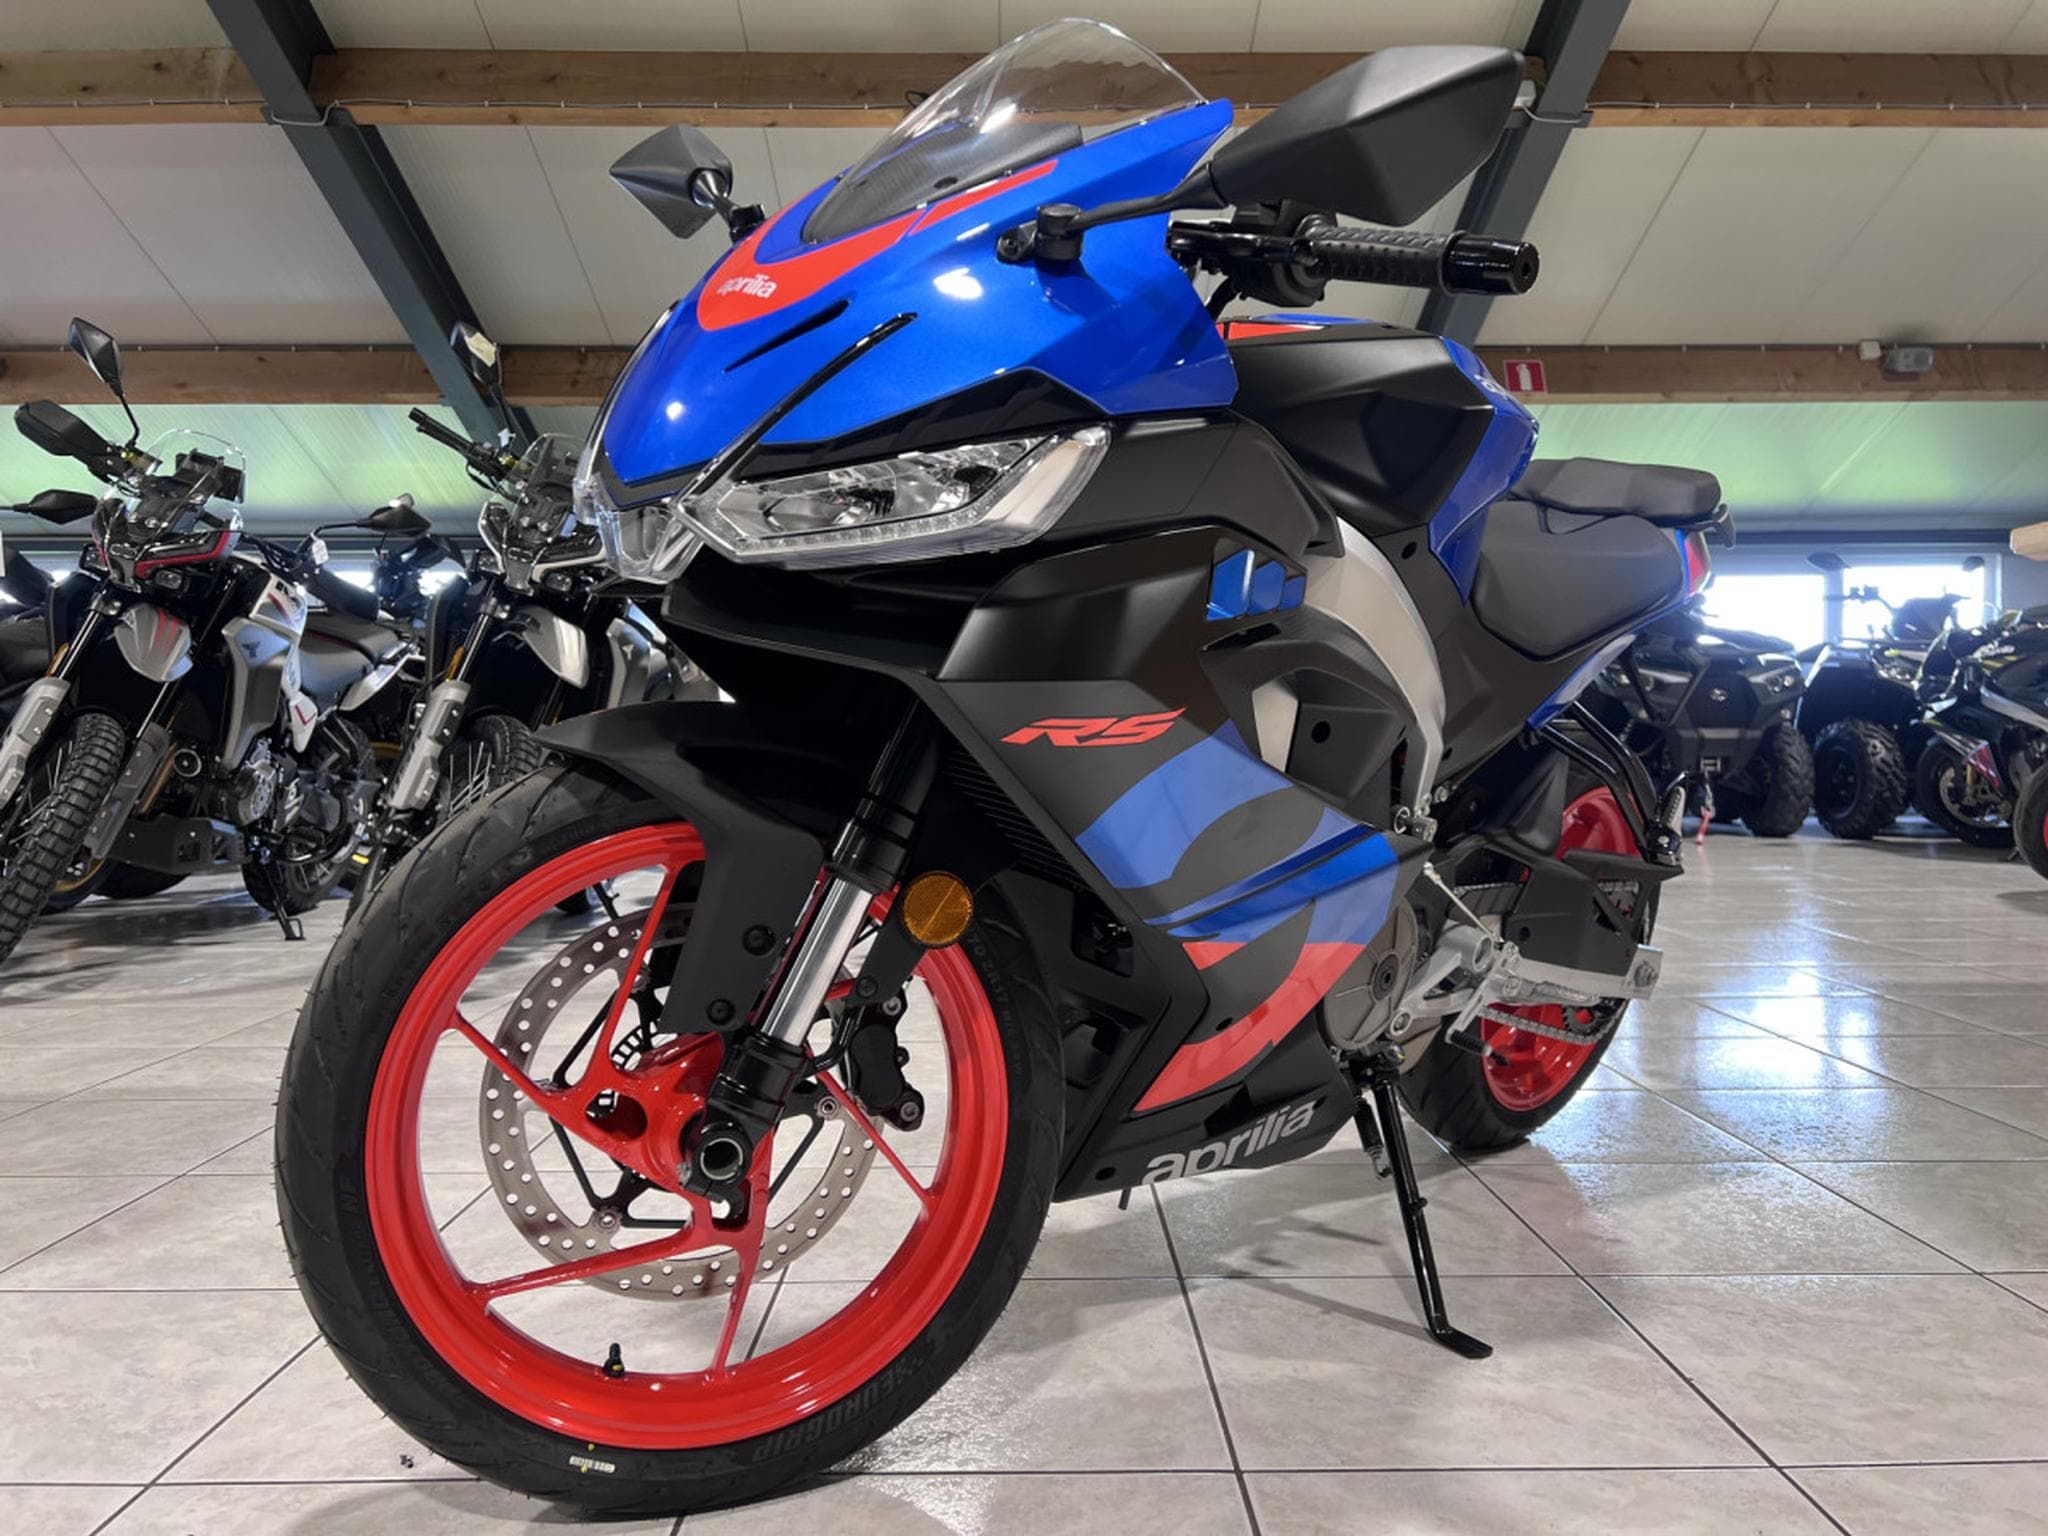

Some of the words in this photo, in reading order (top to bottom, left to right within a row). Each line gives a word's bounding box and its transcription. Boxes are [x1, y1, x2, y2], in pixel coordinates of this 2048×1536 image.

[716, 273, 777, 298] aprilia
[1001, 707, 1187, 747] RS
[1142, 1100, 1317, 1186] aprilia
[755, 1368, 894, 1461] EUROGRIP
